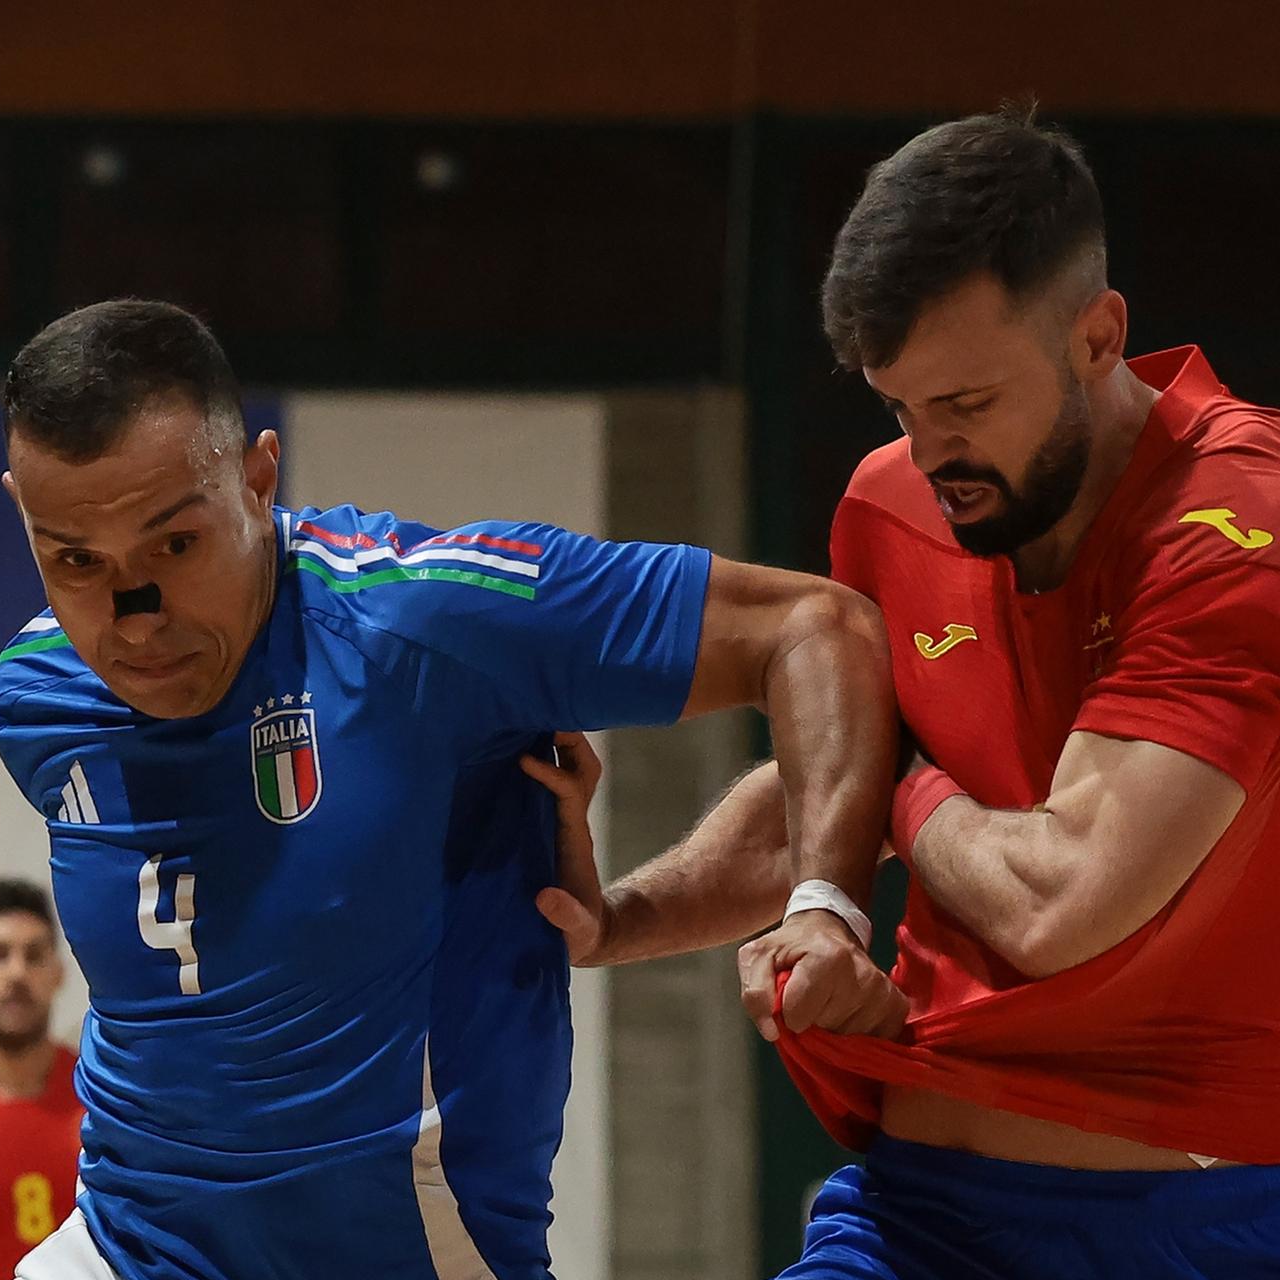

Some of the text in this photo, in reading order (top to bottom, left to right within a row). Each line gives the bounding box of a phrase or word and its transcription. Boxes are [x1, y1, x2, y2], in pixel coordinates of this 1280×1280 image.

[255, 717, 309, 748] ITALIA
[137, 852, 202, 995] 4
[13, 1173, 54, 1244] 8
